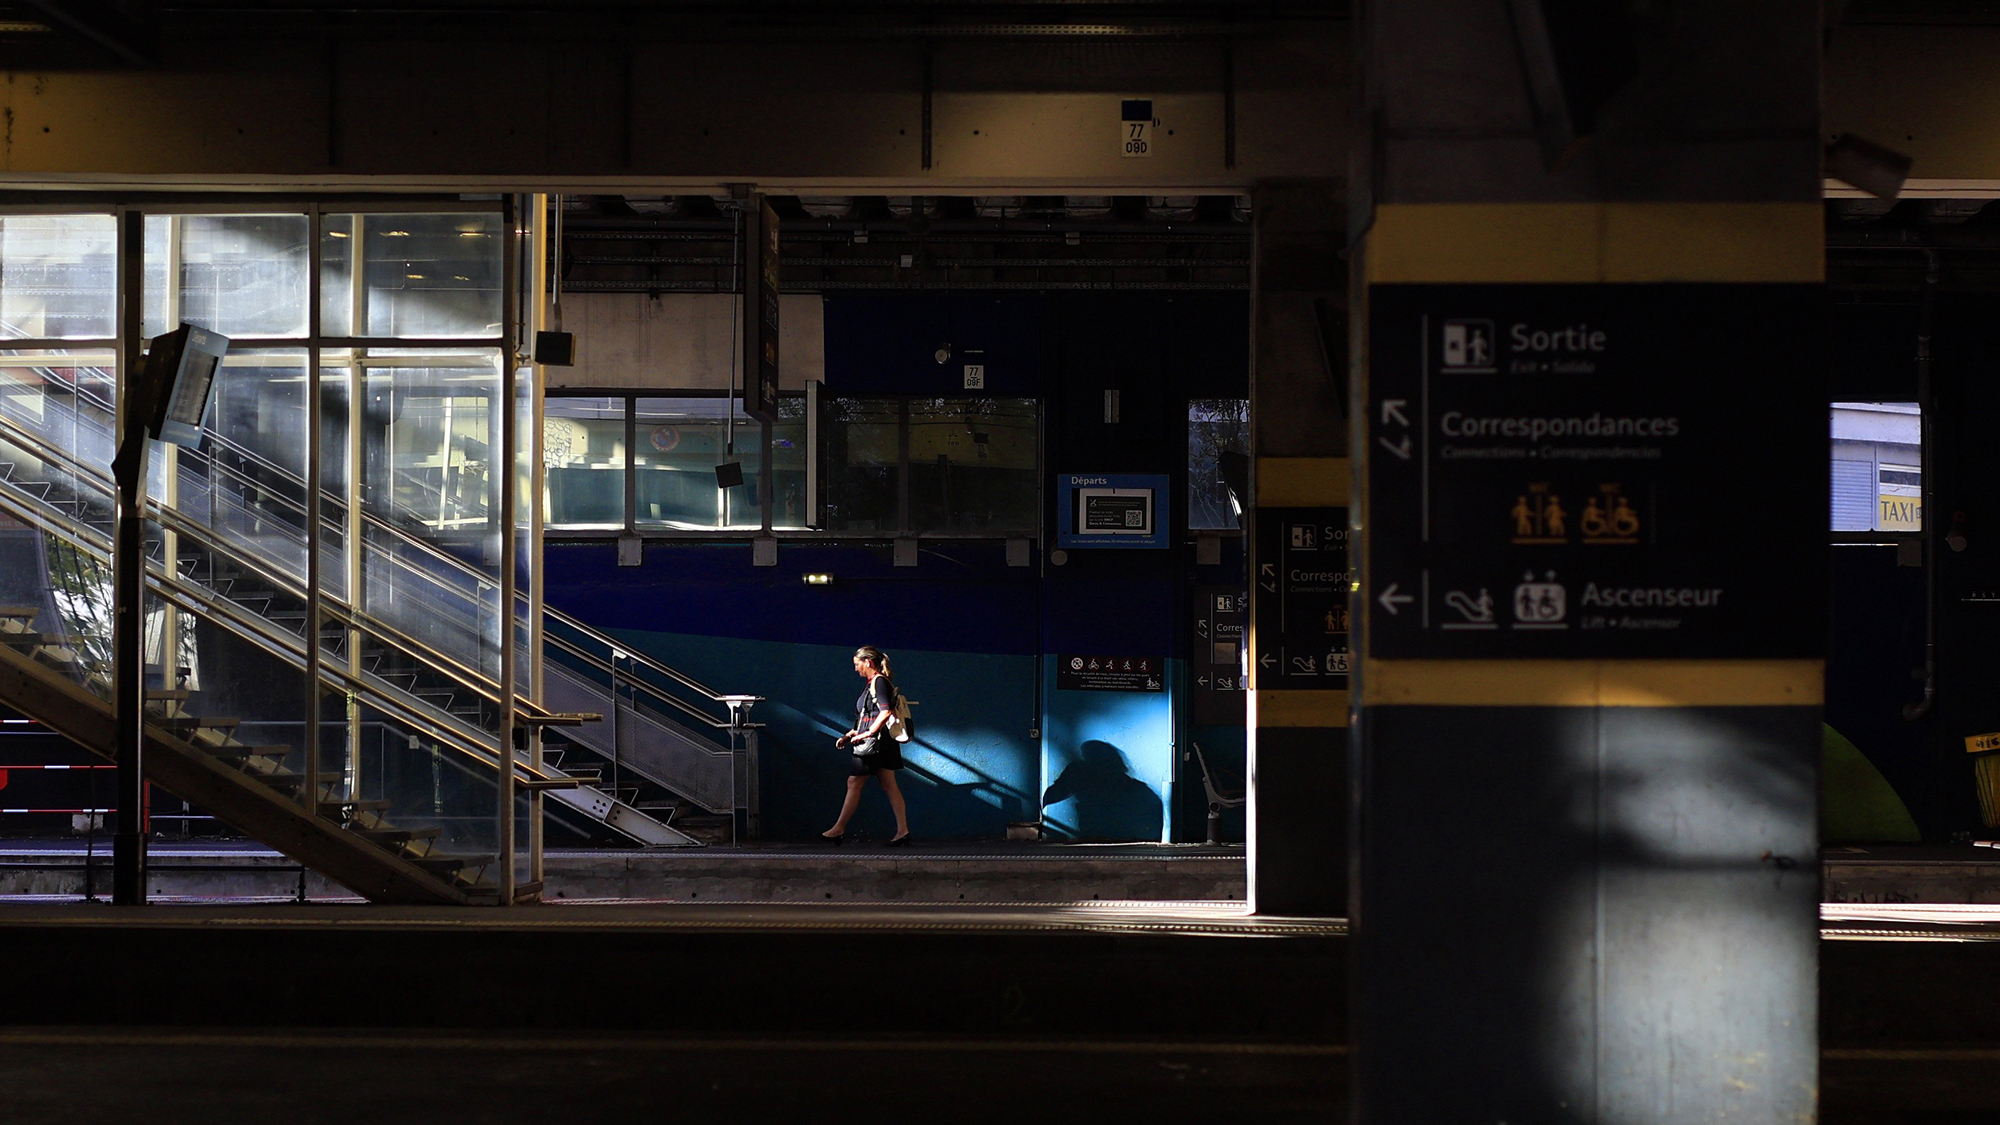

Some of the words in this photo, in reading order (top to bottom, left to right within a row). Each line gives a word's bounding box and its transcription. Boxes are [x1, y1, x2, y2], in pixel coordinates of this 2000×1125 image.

[1130, 123, 1144, 138] 77
[1126, 141, 1147, 153] 09D
[1510, 323, 1607, 351] Sortie
[969, 367, 979, 377] 77
[1440, 410, 1680, 442] Correspondances
[1071, 476, 1108, 486] Départs
[1881, 501, 1914, 522] TAXI
[1581, 581, 1723, 607] Ascenseur
